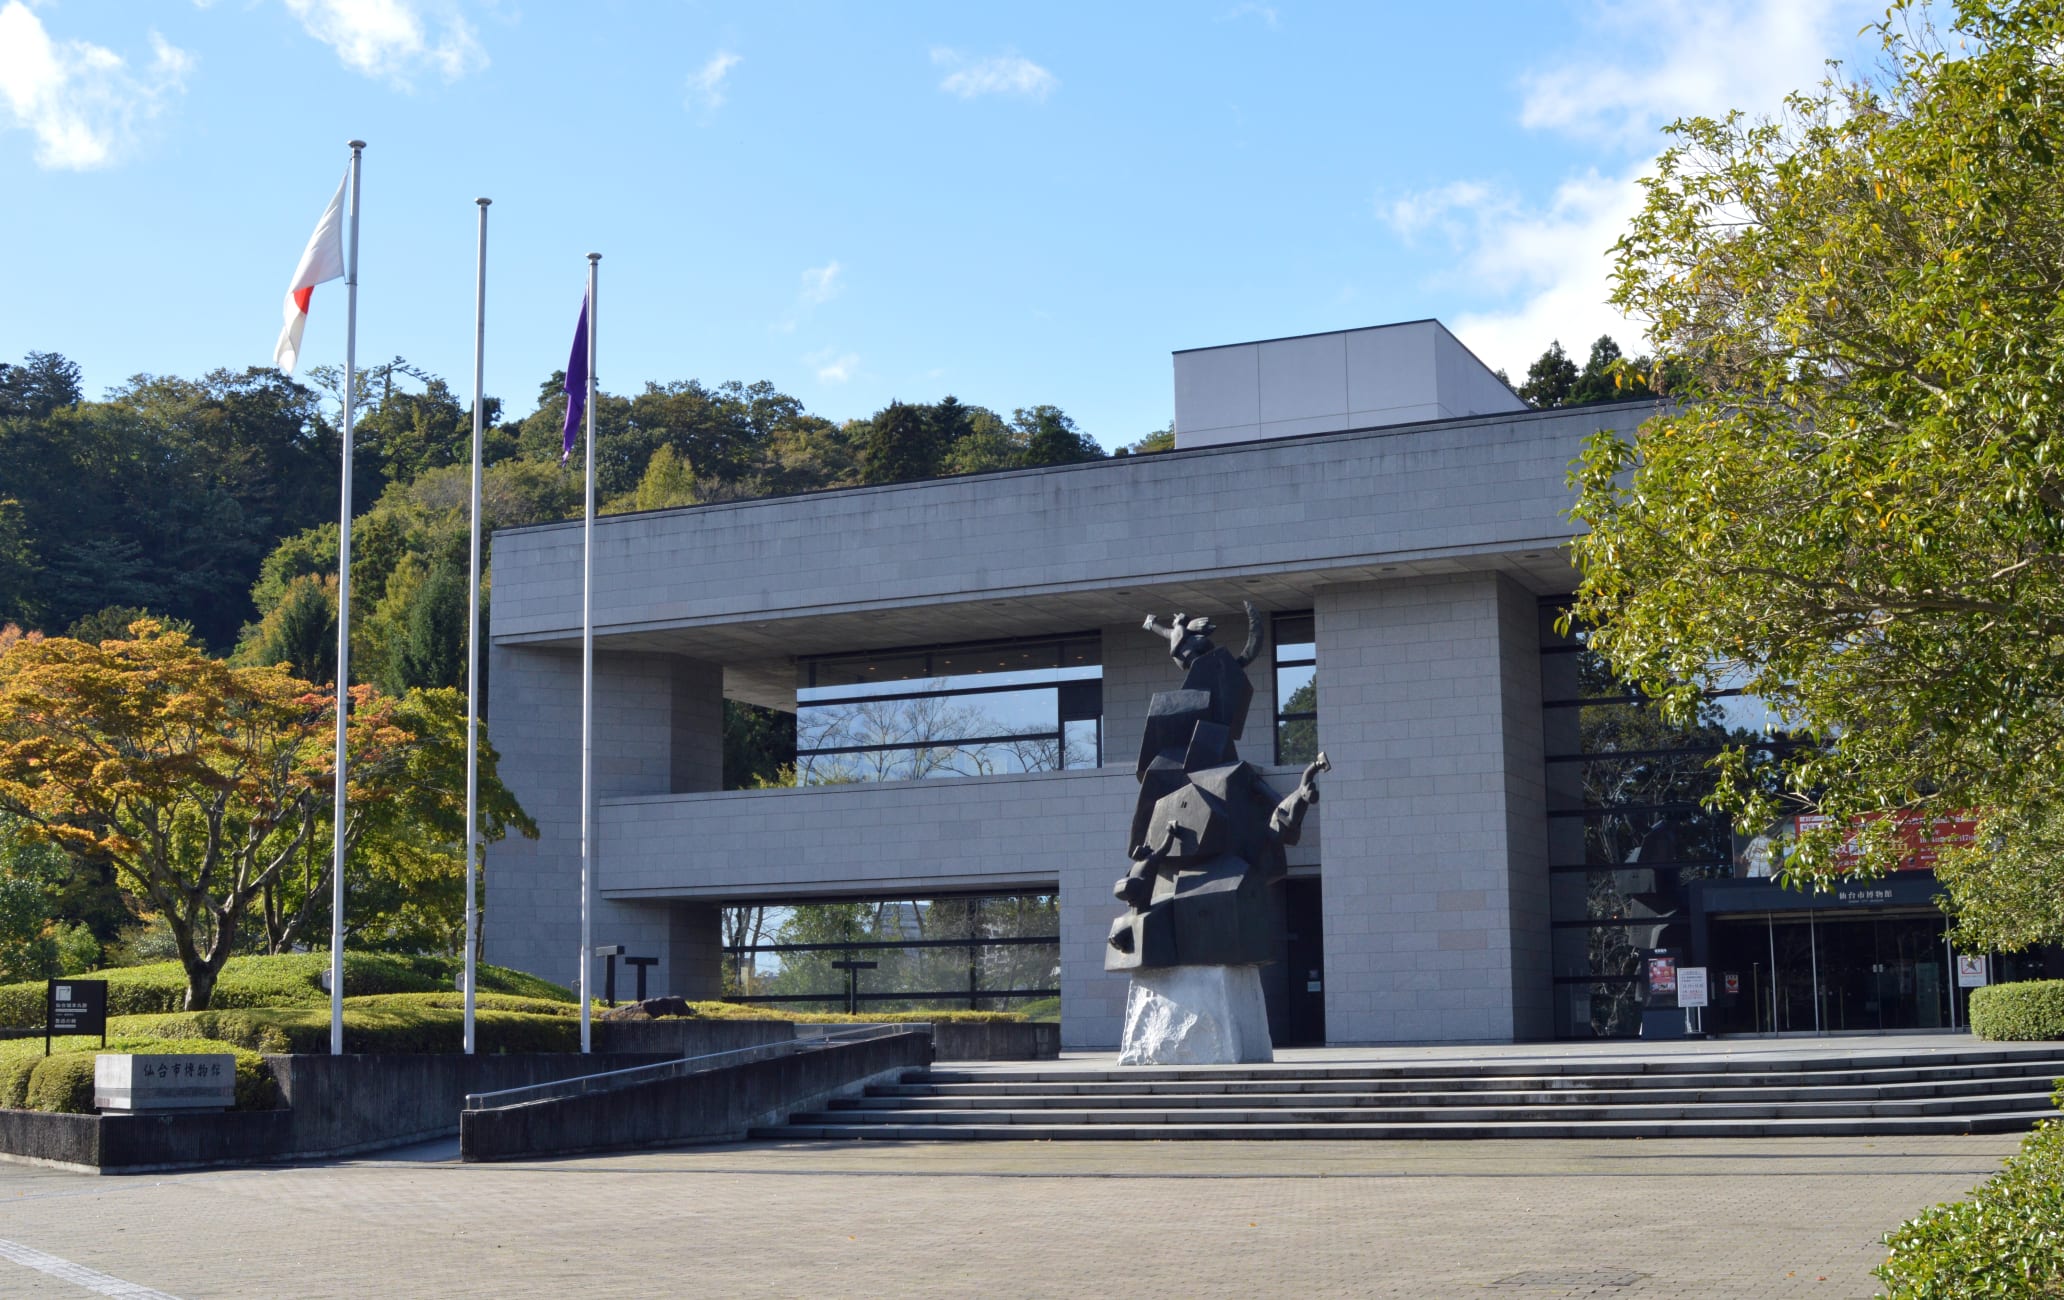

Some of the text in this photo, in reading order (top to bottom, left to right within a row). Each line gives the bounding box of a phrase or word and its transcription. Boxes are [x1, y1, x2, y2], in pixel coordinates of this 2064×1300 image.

[1839, 889, 1893, 900] 仙台市博物館
[143, 1062, 222, 1078] 仙台市博物館
